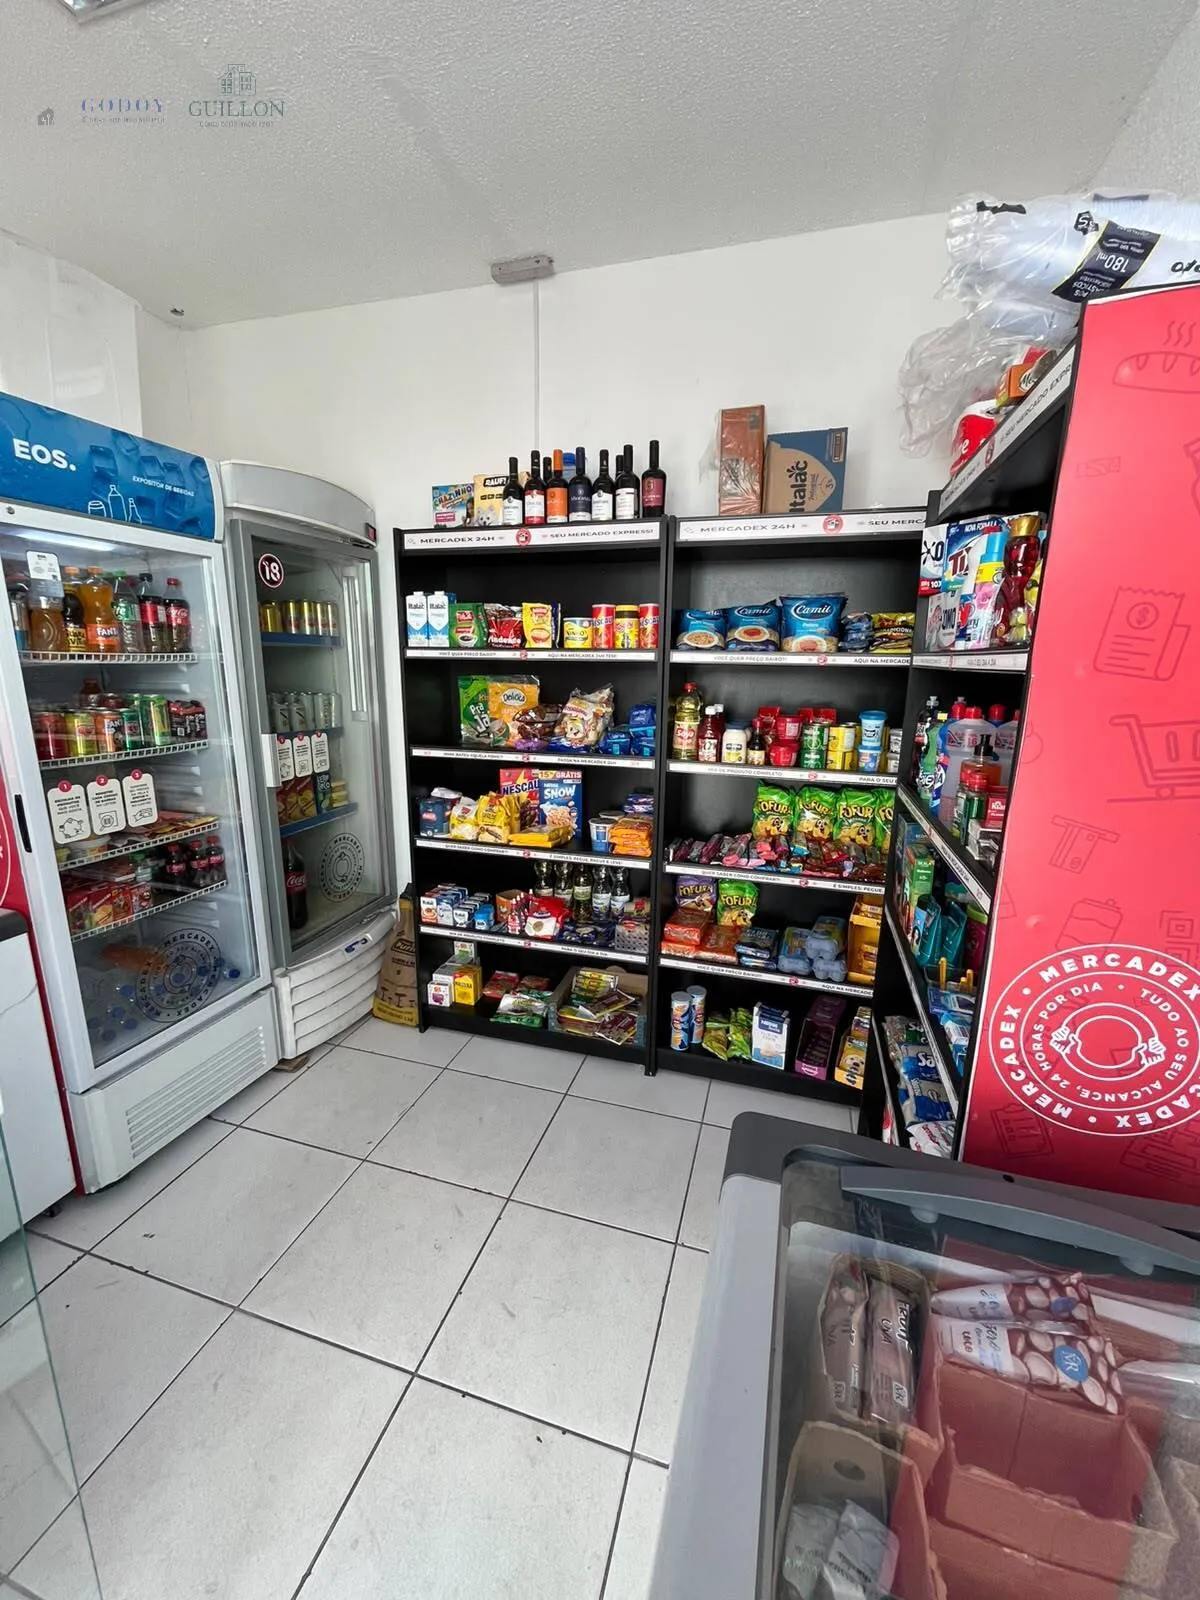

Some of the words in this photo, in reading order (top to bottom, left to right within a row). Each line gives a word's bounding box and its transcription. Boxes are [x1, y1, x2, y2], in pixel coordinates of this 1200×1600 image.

[13, 438, 77, 471] EOS.
[132, 475, 165, 489] EXPOSITOR
[173, 486, 195, 497] BEBIDAS
[567, 530, 611, 538] MERCADO
[700, 523, 767, 534] MERCADEX
[771, 523, 795, 531] 24H
[420, 536, 474, 545] MERCADEX
[475, 535, 495, 543] 24H
[262, 560, 281, 583] 18
[739, 607, 771, 616] Camil
[796, 602, 832, 614] Camil
[95, 627, 118, 636] FANT
[502, 778, 540, 795] NESCAU
[839, 804, 875, 820] FOFUR
[1038, 953, 1200, 1001] MERCADEX
[845, 987, 873, 995] MERCADE
[1070, 982, 1104, 997] DIA
[1038, 994, 1068, 1020] POR
[1138, 987, 1181, 1022] TUDO
[1174, 1027, 1190, 1047] AO
[1031, 1023, 1052, 1072] HORAS
[999, 1003, 1073, 1119] MERCADEX
[1164, 1052, 1188, 1080] SEU
[1050, 1073, 1071, 1089] 24
[1076, 1079, 1163, 1103] ALCANCE,
